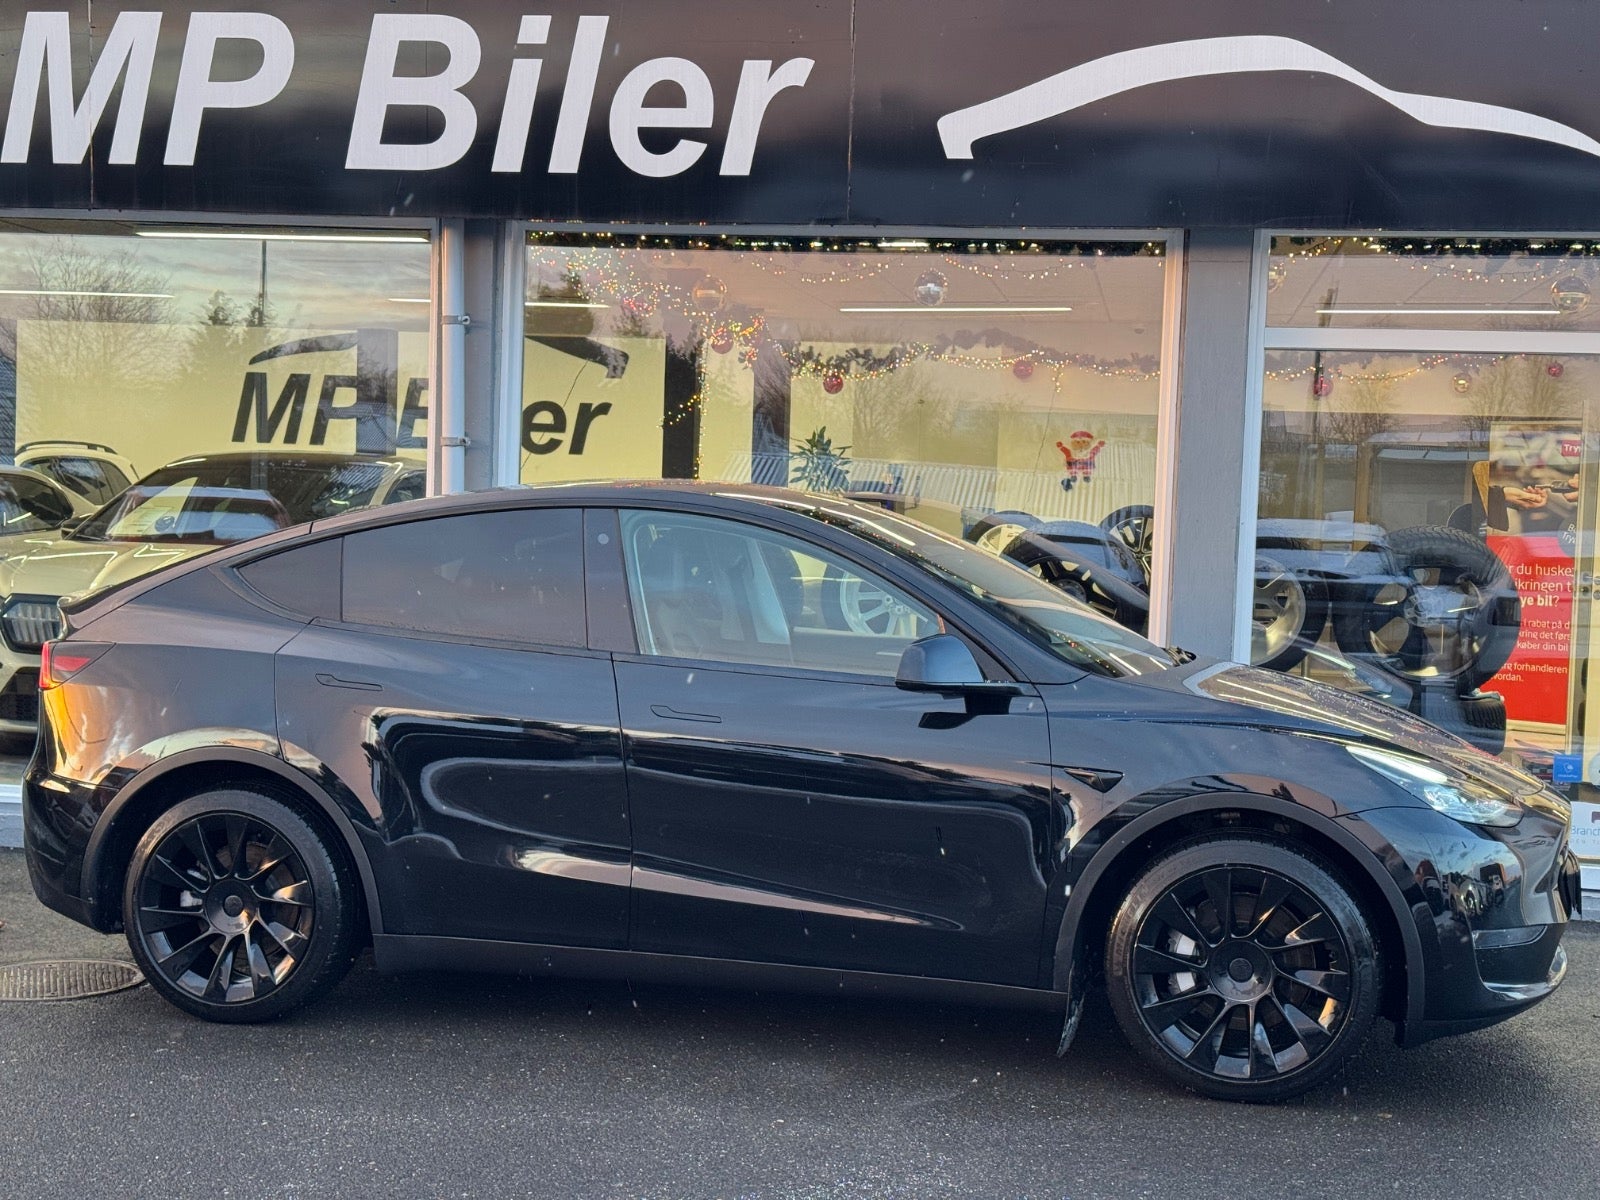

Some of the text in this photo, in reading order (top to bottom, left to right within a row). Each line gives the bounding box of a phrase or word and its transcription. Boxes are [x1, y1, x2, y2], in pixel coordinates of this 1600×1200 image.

[1, 11, 815, 178] MP Biler
[1517, 563, 1532, 575] du
[1537, 594, 1560, 607] bil?
[1528, 619, 1550, 628] rabat
[1552, 620, 1562, 630] på
[1540, 631, 1553, 640] det
[1542, 641, 1556, 651] din
[1558, 642, 1568, 652] bil
[1514, 661, 1568, 674] forhandleren
